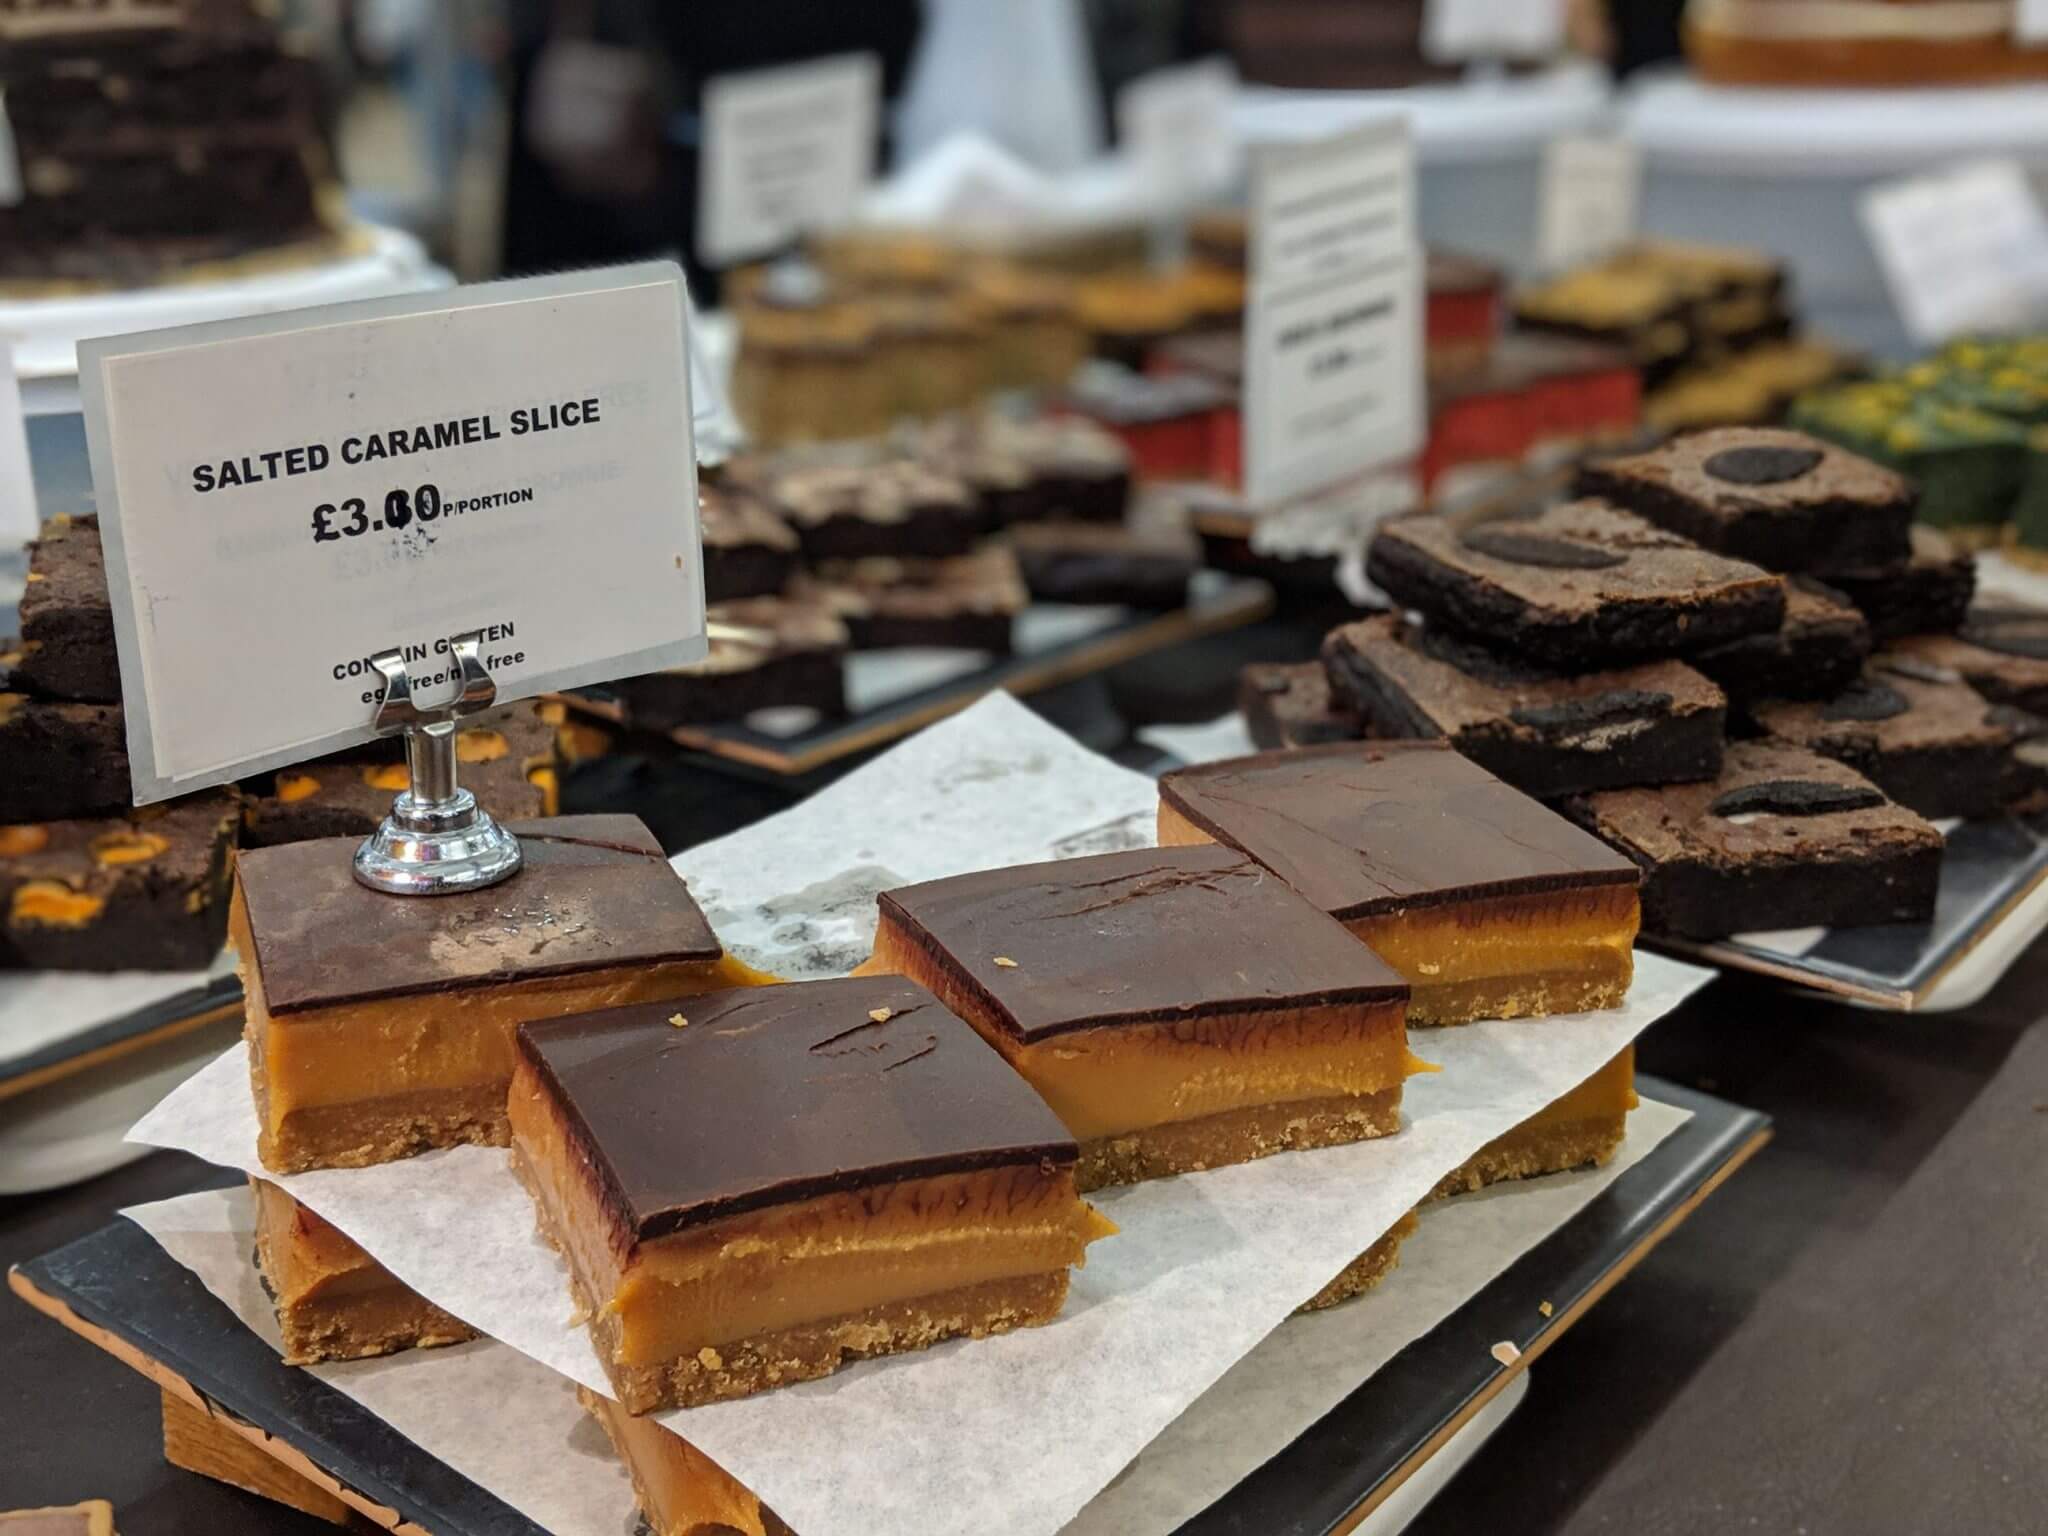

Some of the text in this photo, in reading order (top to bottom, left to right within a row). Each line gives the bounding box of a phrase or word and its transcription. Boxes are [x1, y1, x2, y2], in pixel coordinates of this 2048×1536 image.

[192, 398, 602, 493] SALTED CARAMEL SLICE
[443, 487, 534, 518] P/PORTION
[333, 621, 514, 681] CONIN GTEN
[486, 651, 525, 671] free
